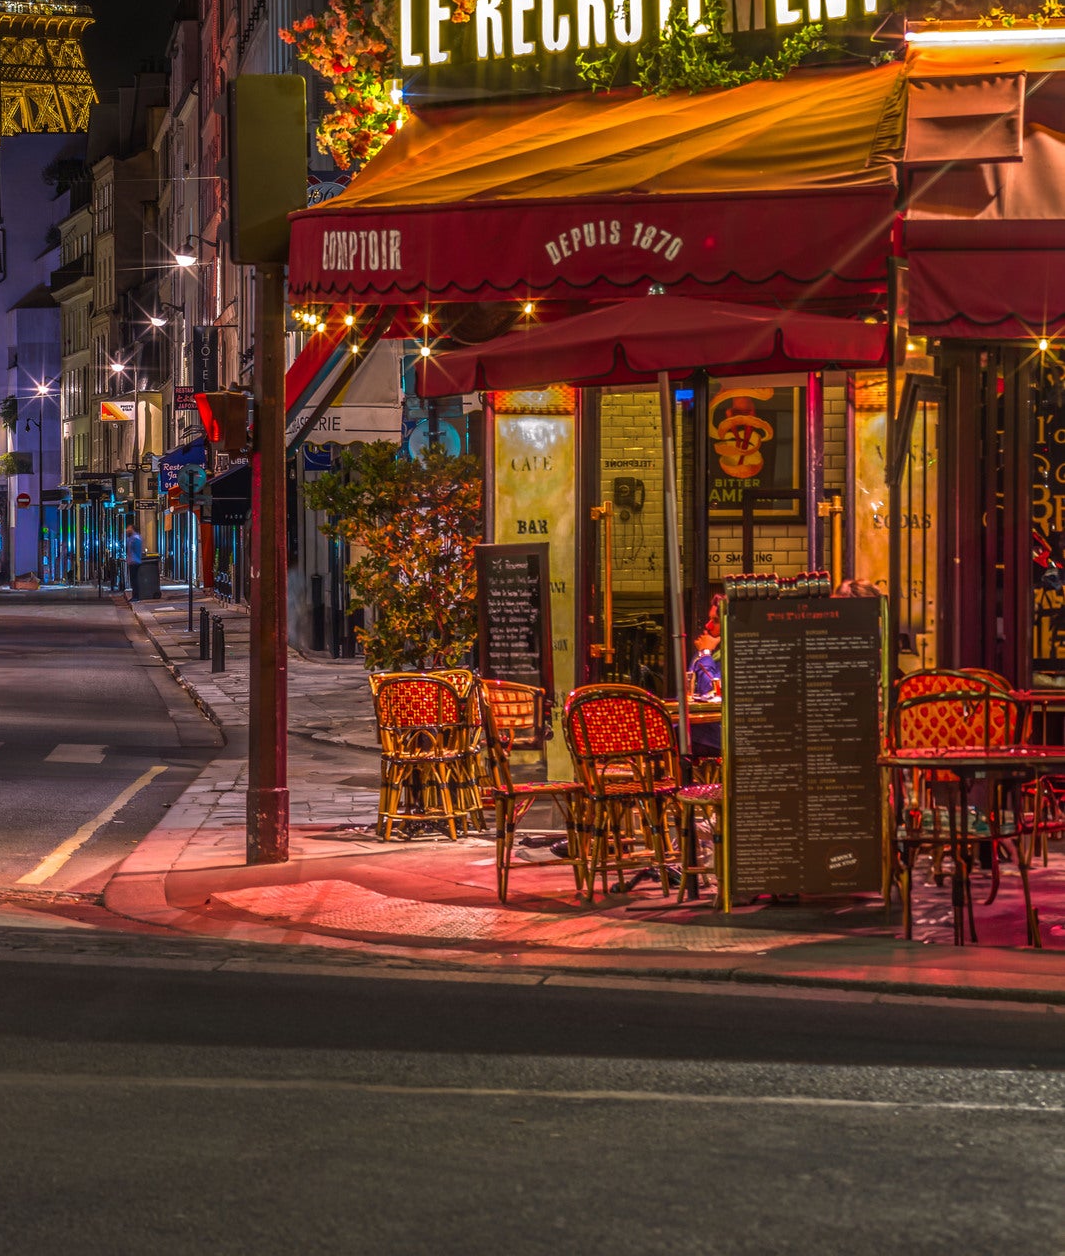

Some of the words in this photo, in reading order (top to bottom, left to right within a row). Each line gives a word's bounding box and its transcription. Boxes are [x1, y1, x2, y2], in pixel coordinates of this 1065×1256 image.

[322, 230, 402, 271] COMPTOIR
[545, 220, 621, 266] DEPUIS
[632, 222, 684, 262] 1870
[201, 333, 210, 392] HOTEL
[715, 478, 761, 488] BITTER
[517, 520, 549, 535] BAR
